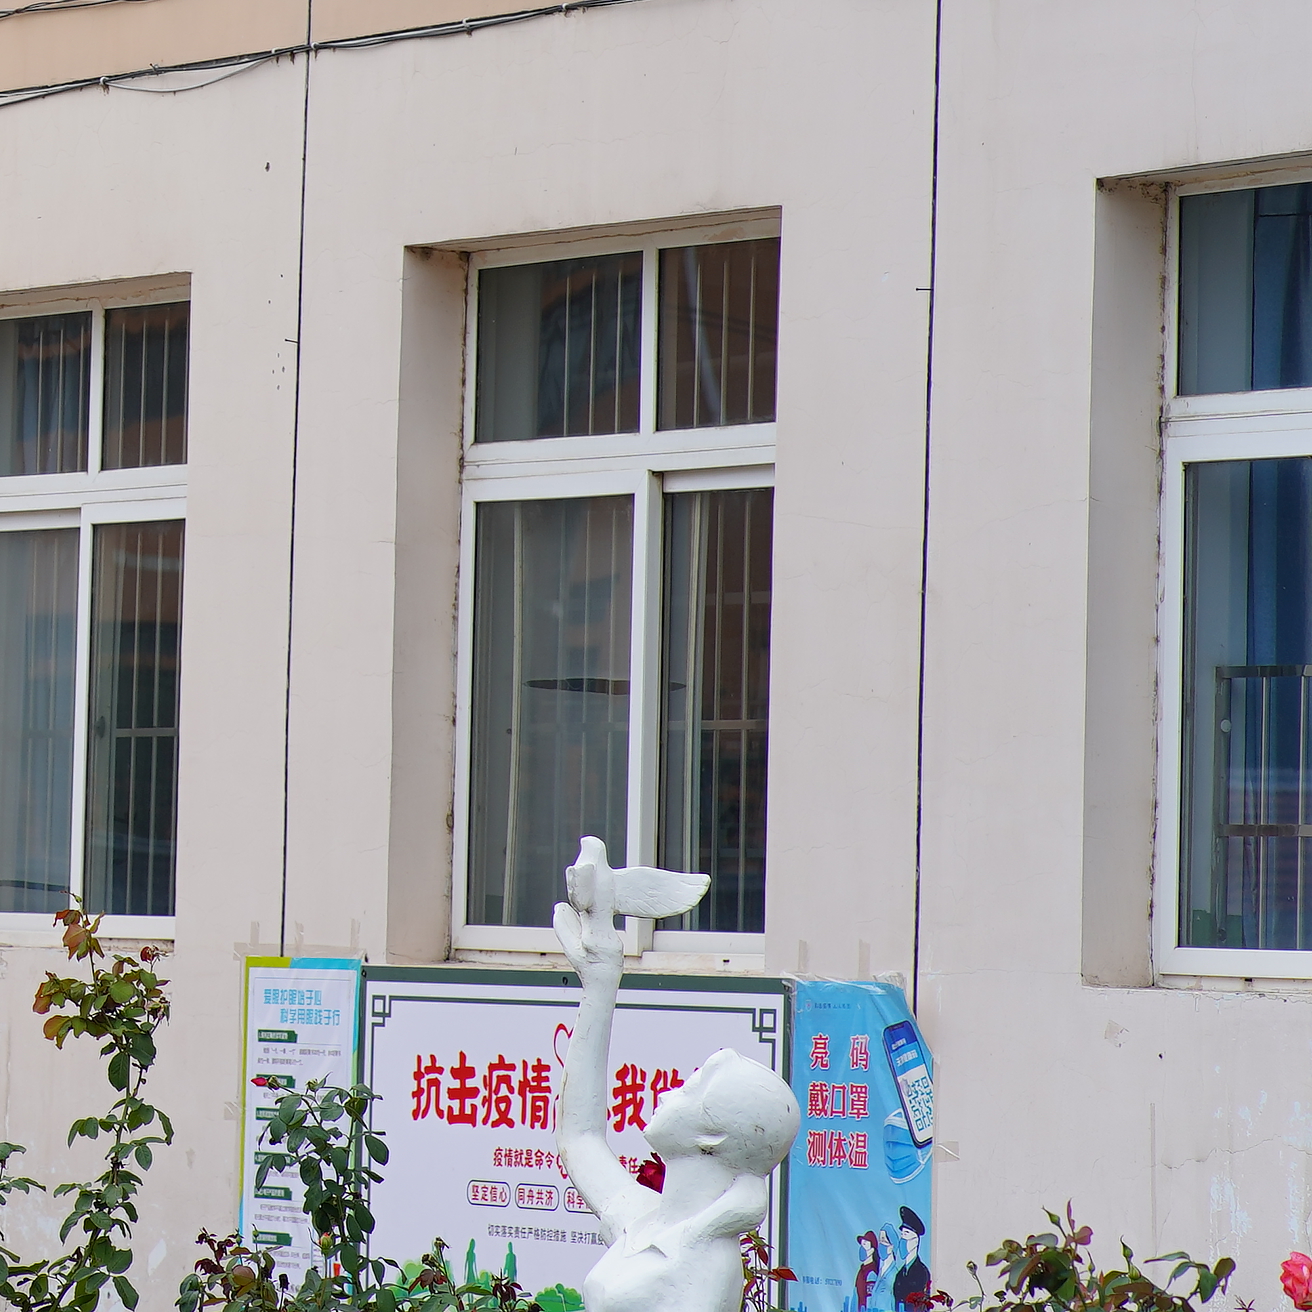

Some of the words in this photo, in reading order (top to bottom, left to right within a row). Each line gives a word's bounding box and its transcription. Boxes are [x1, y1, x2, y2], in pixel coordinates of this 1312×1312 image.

[411, 1049, 552, 1130] 抗击疫情
[807, 1080, 870, 1120] 戴口罩
[492, 1146, 556, 1171] 疫情就是命令
[806, 1128, 869, 1169] 测体温
[471, 1184, 508, 1203] 坚定信心
[517, 1187, 554, 1207] 同舟共济
[567, 1191, 593, 1209] 科学
[487, 1223, 567, 1243] 切实落实责任严格防控措施
